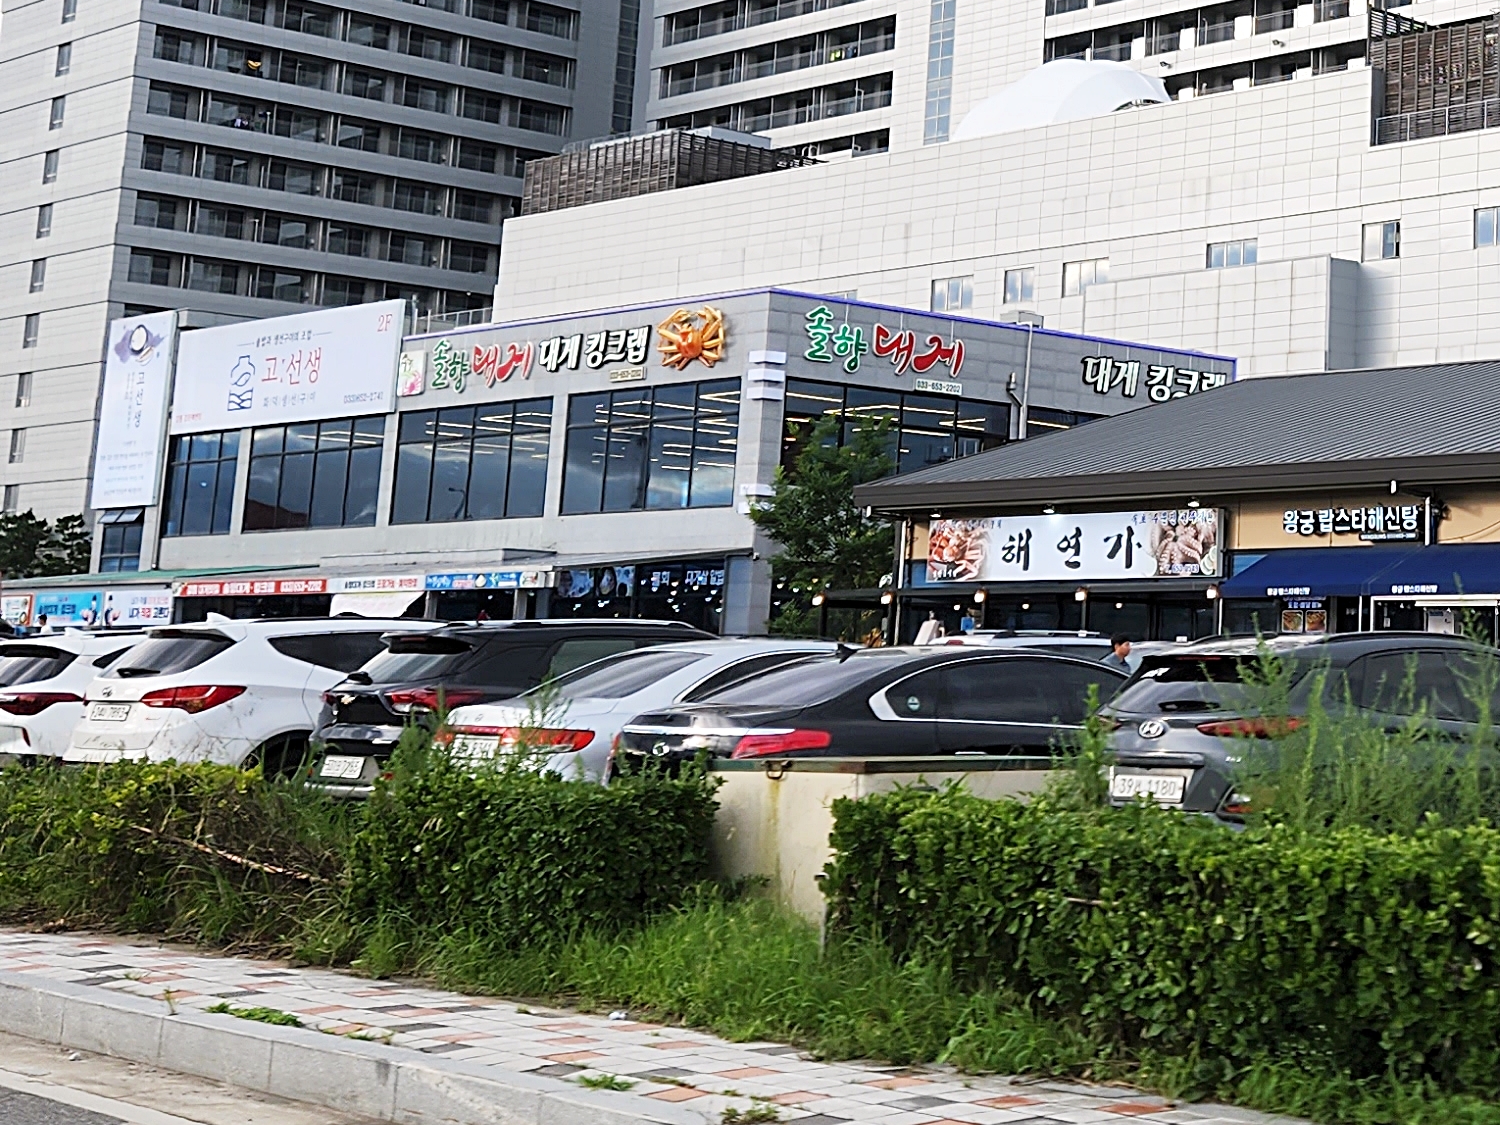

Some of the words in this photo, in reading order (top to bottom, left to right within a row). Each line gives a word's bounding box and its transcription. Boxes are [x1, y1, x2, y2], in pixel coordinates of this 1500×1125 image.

[377, 314, 393, 332] 2F
[539, 335, 582, 371] 대게
[584, 325, 651, 367] 킹크랩
[917, 380, 961, 393] 033-653-2202
[1083, 356, 1140, 398] 대게
[1283, 510, 1316, 535] 왕궁
[1318, 504, 1419, 533] 랍스타해신탕
